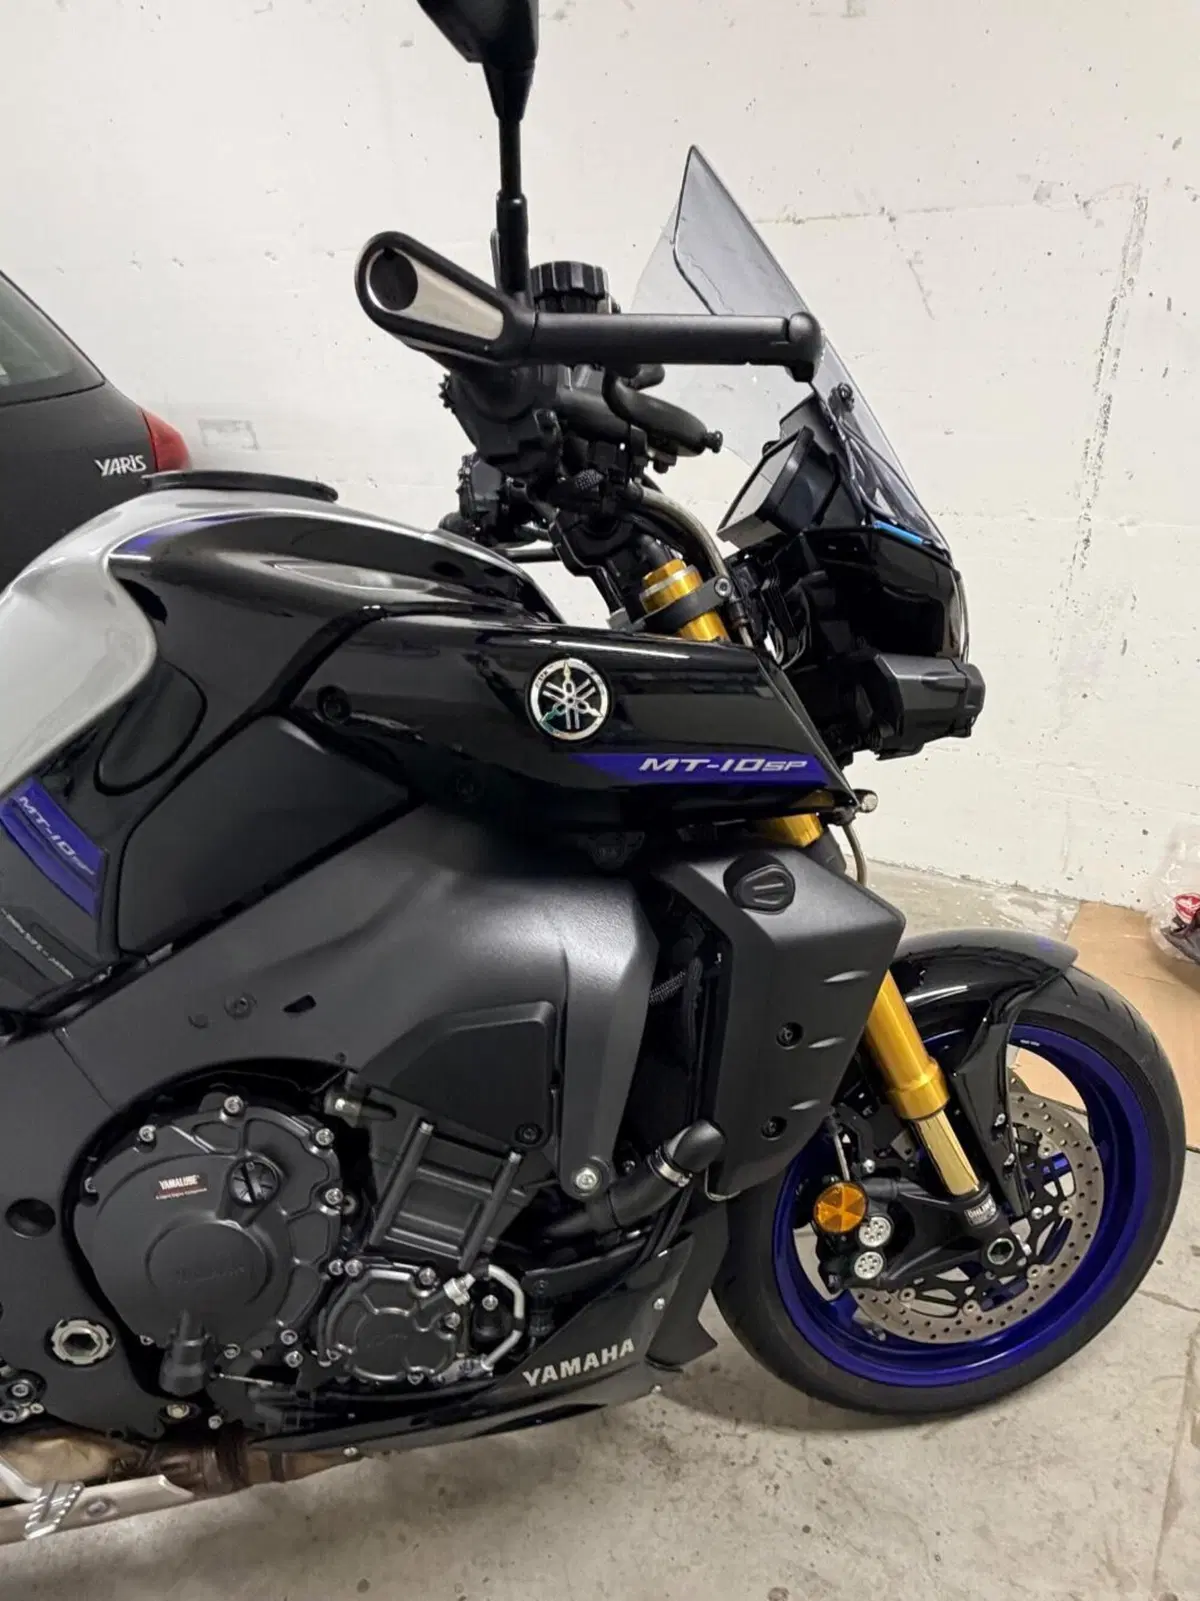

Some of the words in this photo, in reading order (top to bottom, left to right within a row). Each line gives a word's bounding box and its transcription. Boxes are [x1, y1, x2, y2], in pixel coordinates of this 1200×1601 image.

[94, 454, 147, 476] YARIS
[639, 758, 808, 772] MT-10SP
[522, 1338, 635, 1387] YAMAHA
